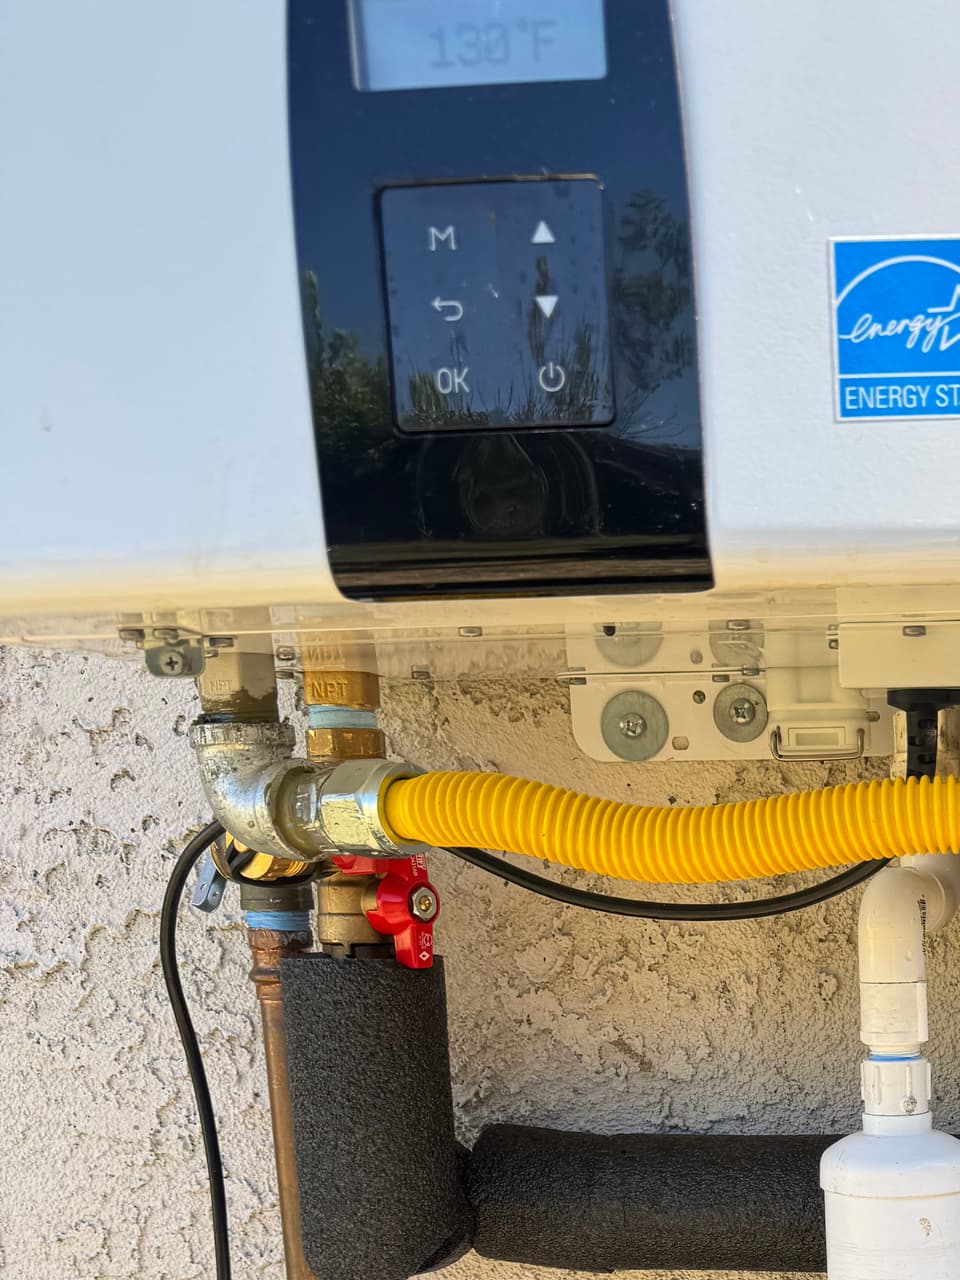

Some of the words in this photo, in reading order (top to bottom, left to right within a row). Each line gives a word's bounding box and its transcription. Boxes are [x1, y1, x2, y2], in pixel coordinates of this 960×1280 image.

[429, 225, 457, 251] M
[437, 367, 470, 394] OK
[844, 384, 930, 410] ENERGY
[210, 679, 233, 693] NPT
[311, 679, 348, 699] NPT
